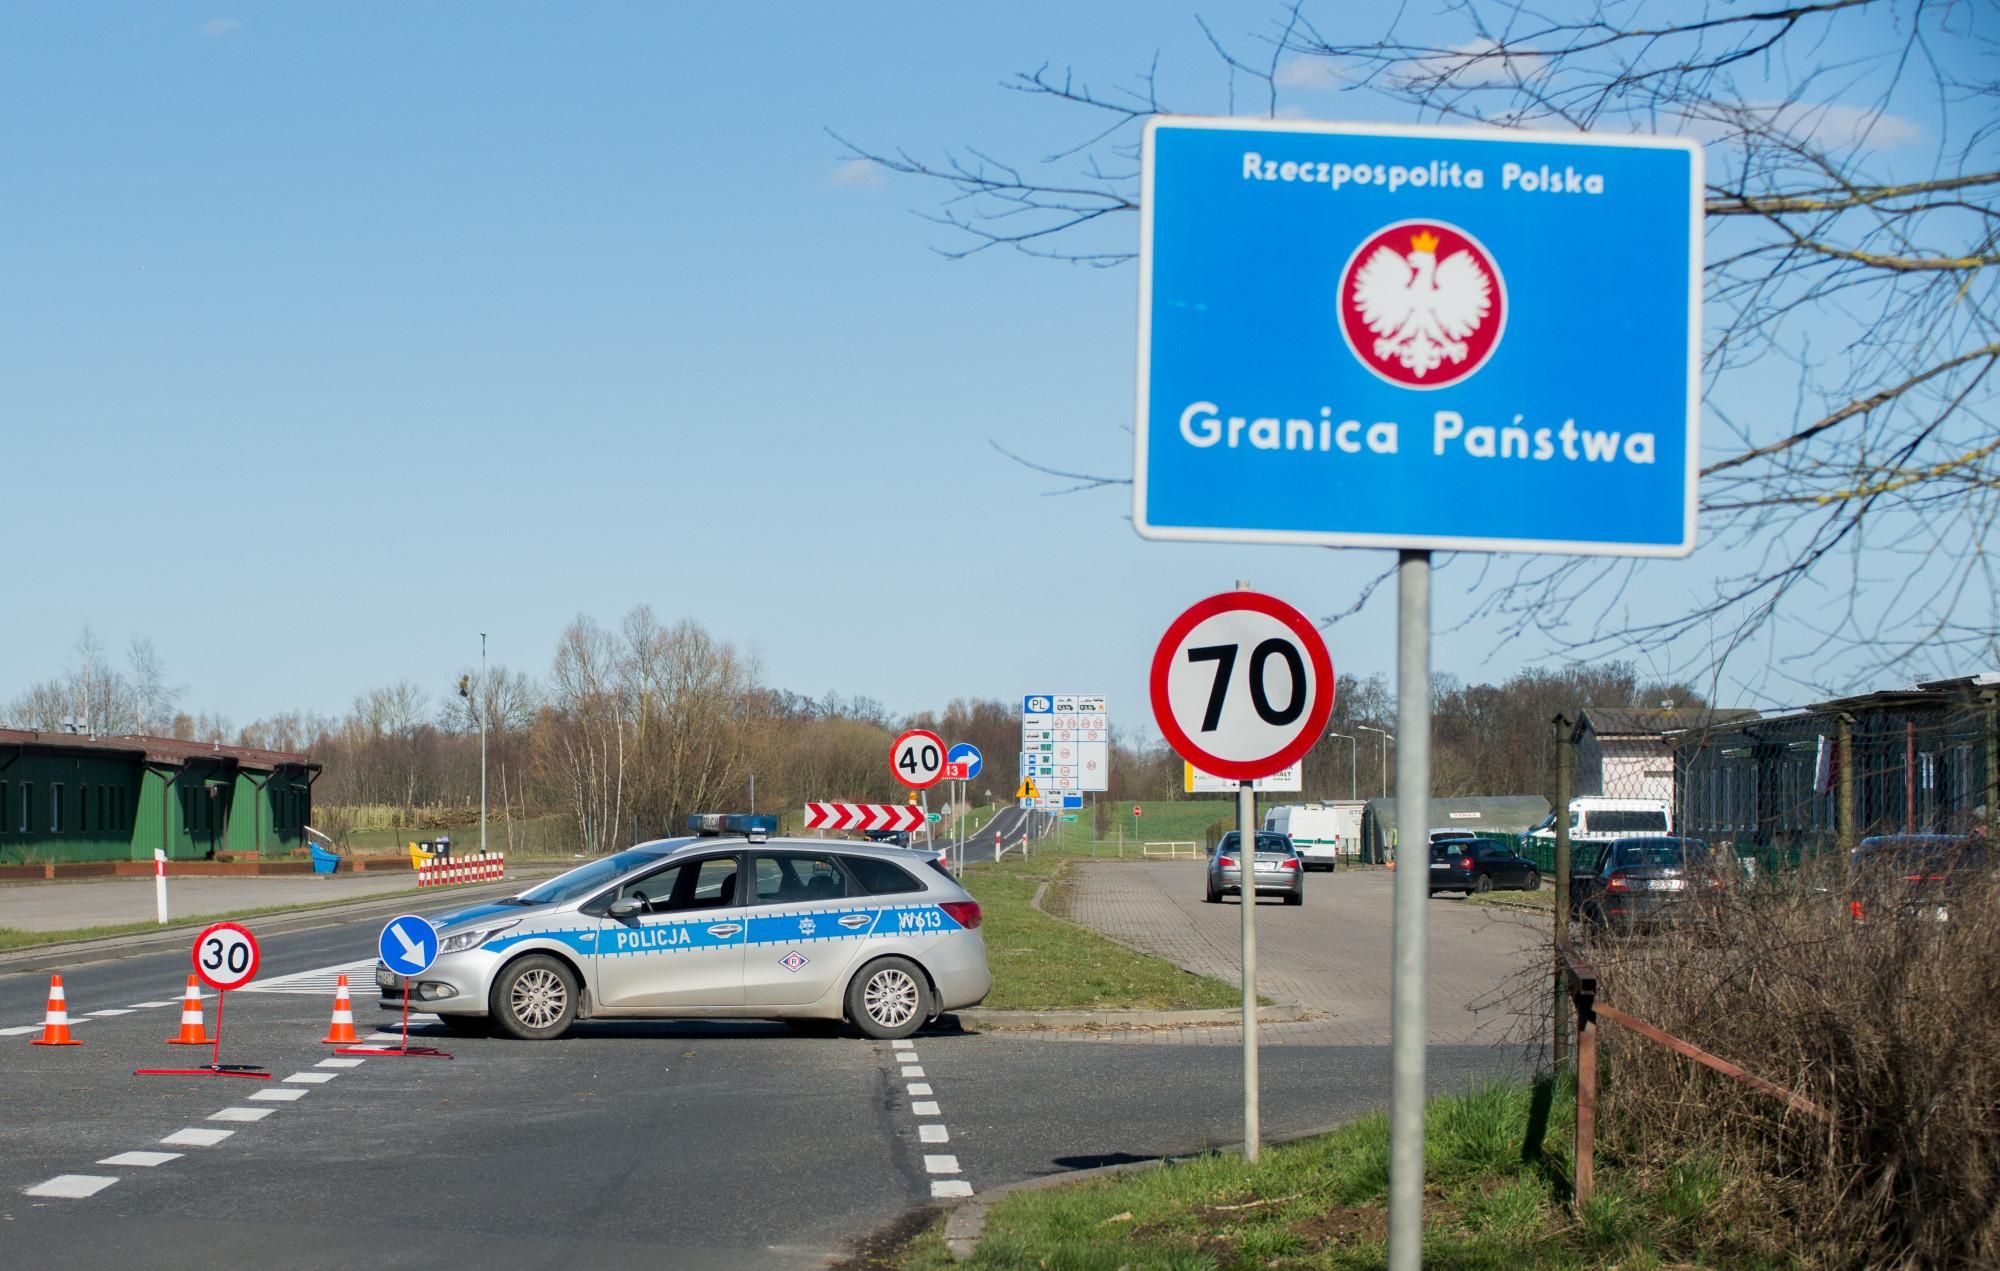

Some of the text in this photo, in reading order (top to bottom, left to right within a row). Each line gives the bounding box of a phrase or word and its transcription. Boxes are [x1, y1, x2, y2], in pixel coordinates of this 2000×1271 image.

[1242, 152, 1604, 195] Rzeczpospolita Polska
[1179, 401, 1656, 464] Granica Państwa
[1187, 638, 1307, 733] 70
[1032, 699, 1045, 710] PL
[899, 744, 939, 774] 40
[946, 765, 959, 776] 13
[897, 911, 942, 931] W613
[616, 927, 691, 950] POLICJA
[202, 938, 249, 974] 30
